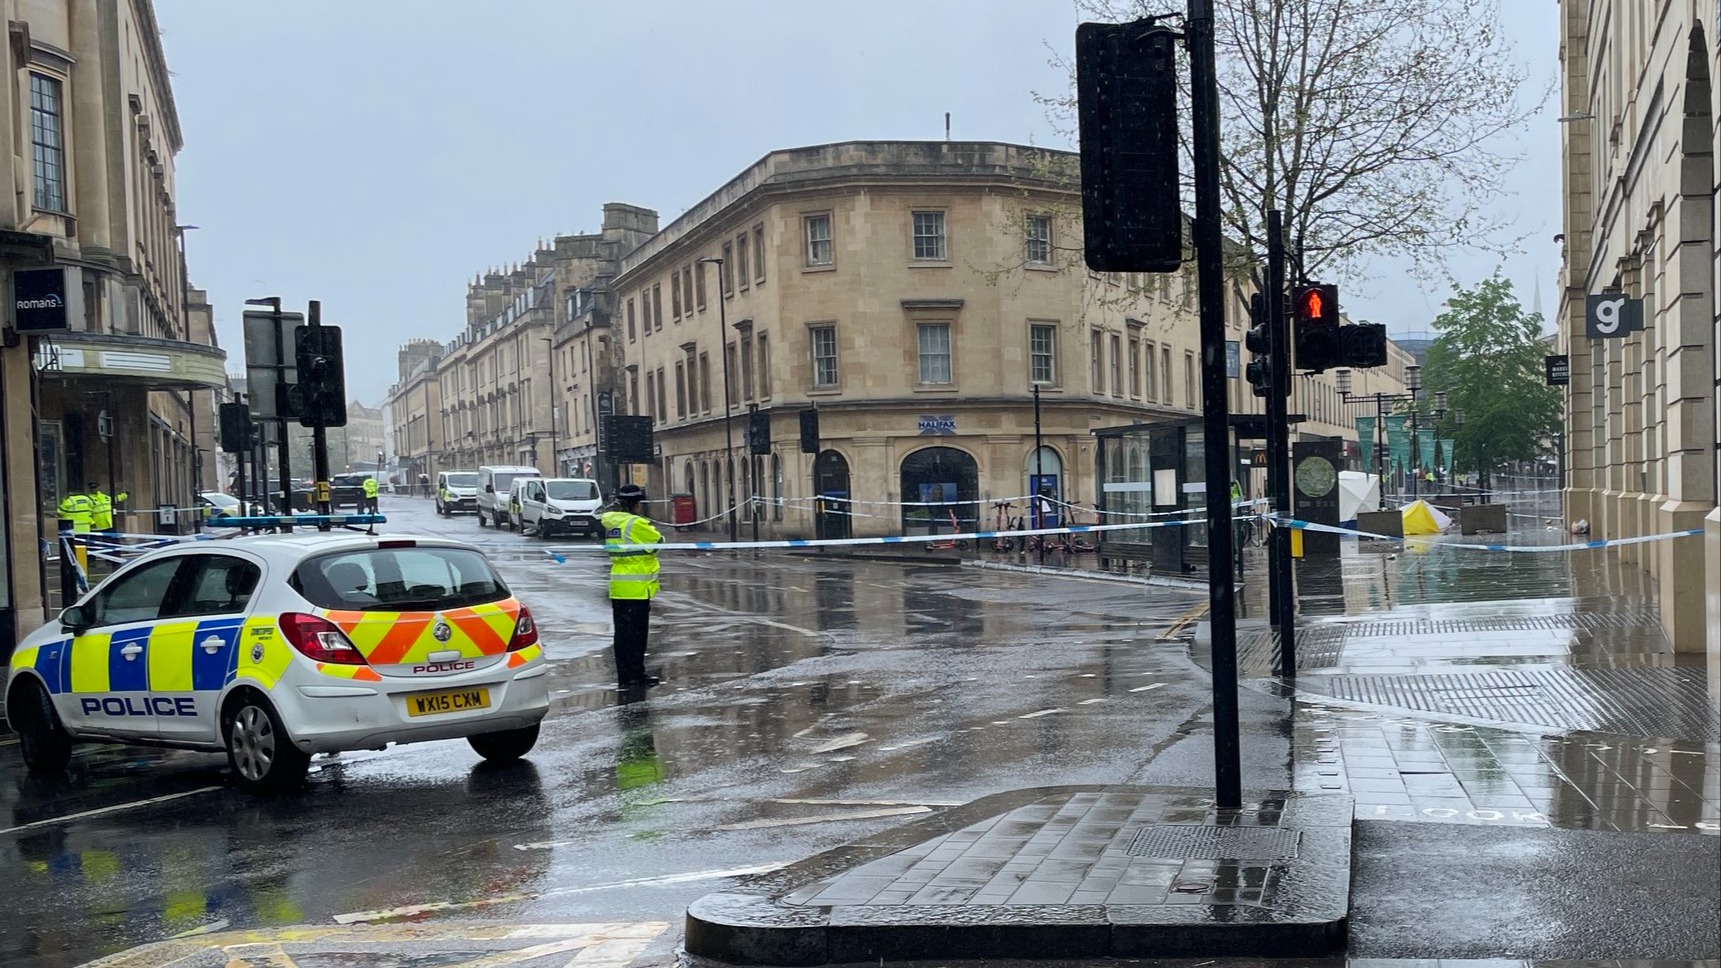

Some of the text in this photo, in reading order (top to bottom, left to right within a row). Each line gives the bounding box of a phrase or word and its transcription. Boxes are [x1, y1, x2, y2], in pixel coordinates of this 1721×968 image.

[918, 420, 957, 430] HALIFAX
[413, 661, 475, 674] POLICE
[80, 697, 198, 716] POLICE
[415, 691, 482, 713] WX15 CXM
